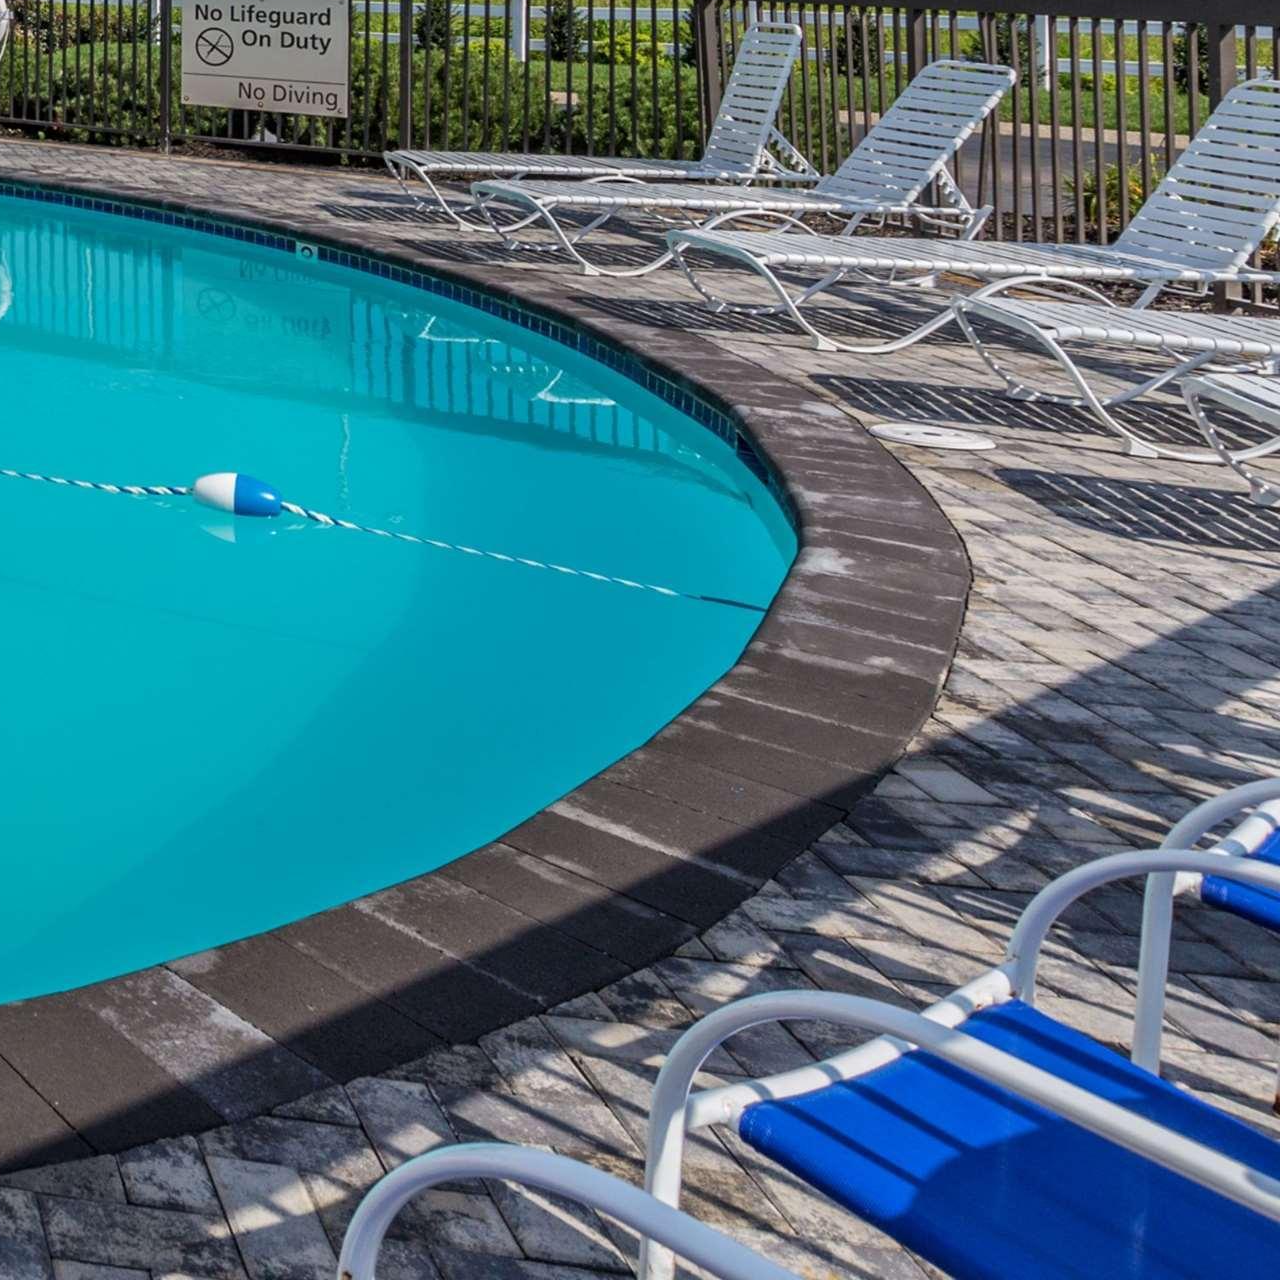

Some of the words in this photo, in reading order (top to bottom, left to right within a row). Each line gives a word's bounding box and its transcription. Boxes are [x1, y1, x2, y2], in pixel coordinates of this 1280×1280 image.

[195, 4, 222, 21] No
[230, 5, 331, 28] Lifeguard
[241, 29, 271, 48] On
[280, 31, 332, 56] Duty
[238, 82, 265, 101] No
[273, 85, 338, 111] Diving
